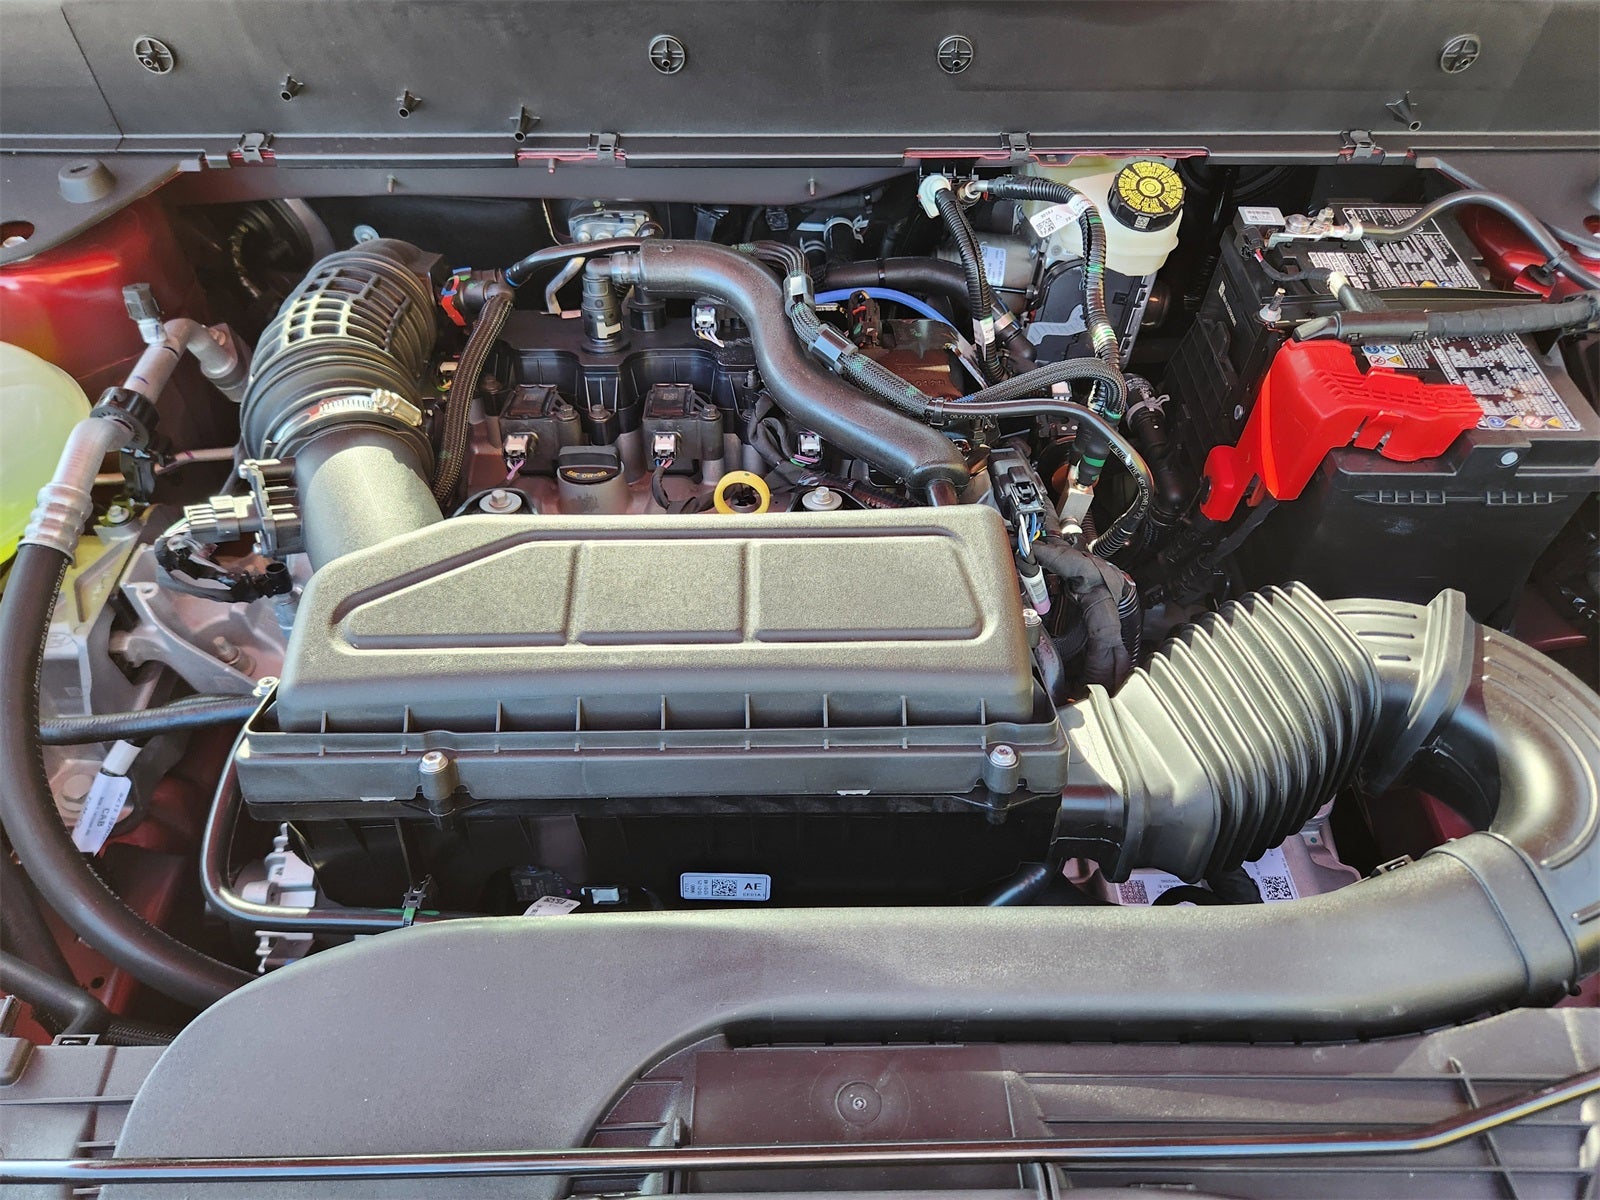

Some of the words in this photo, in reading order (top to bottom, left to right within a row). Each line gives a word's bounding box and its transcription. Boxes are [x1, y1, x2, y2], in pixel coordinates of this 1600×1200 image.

[53, 557, 69, 595] SUCTION
[46, 595, 57, 619] HOSE
[744, 883, 763, 891] AE
